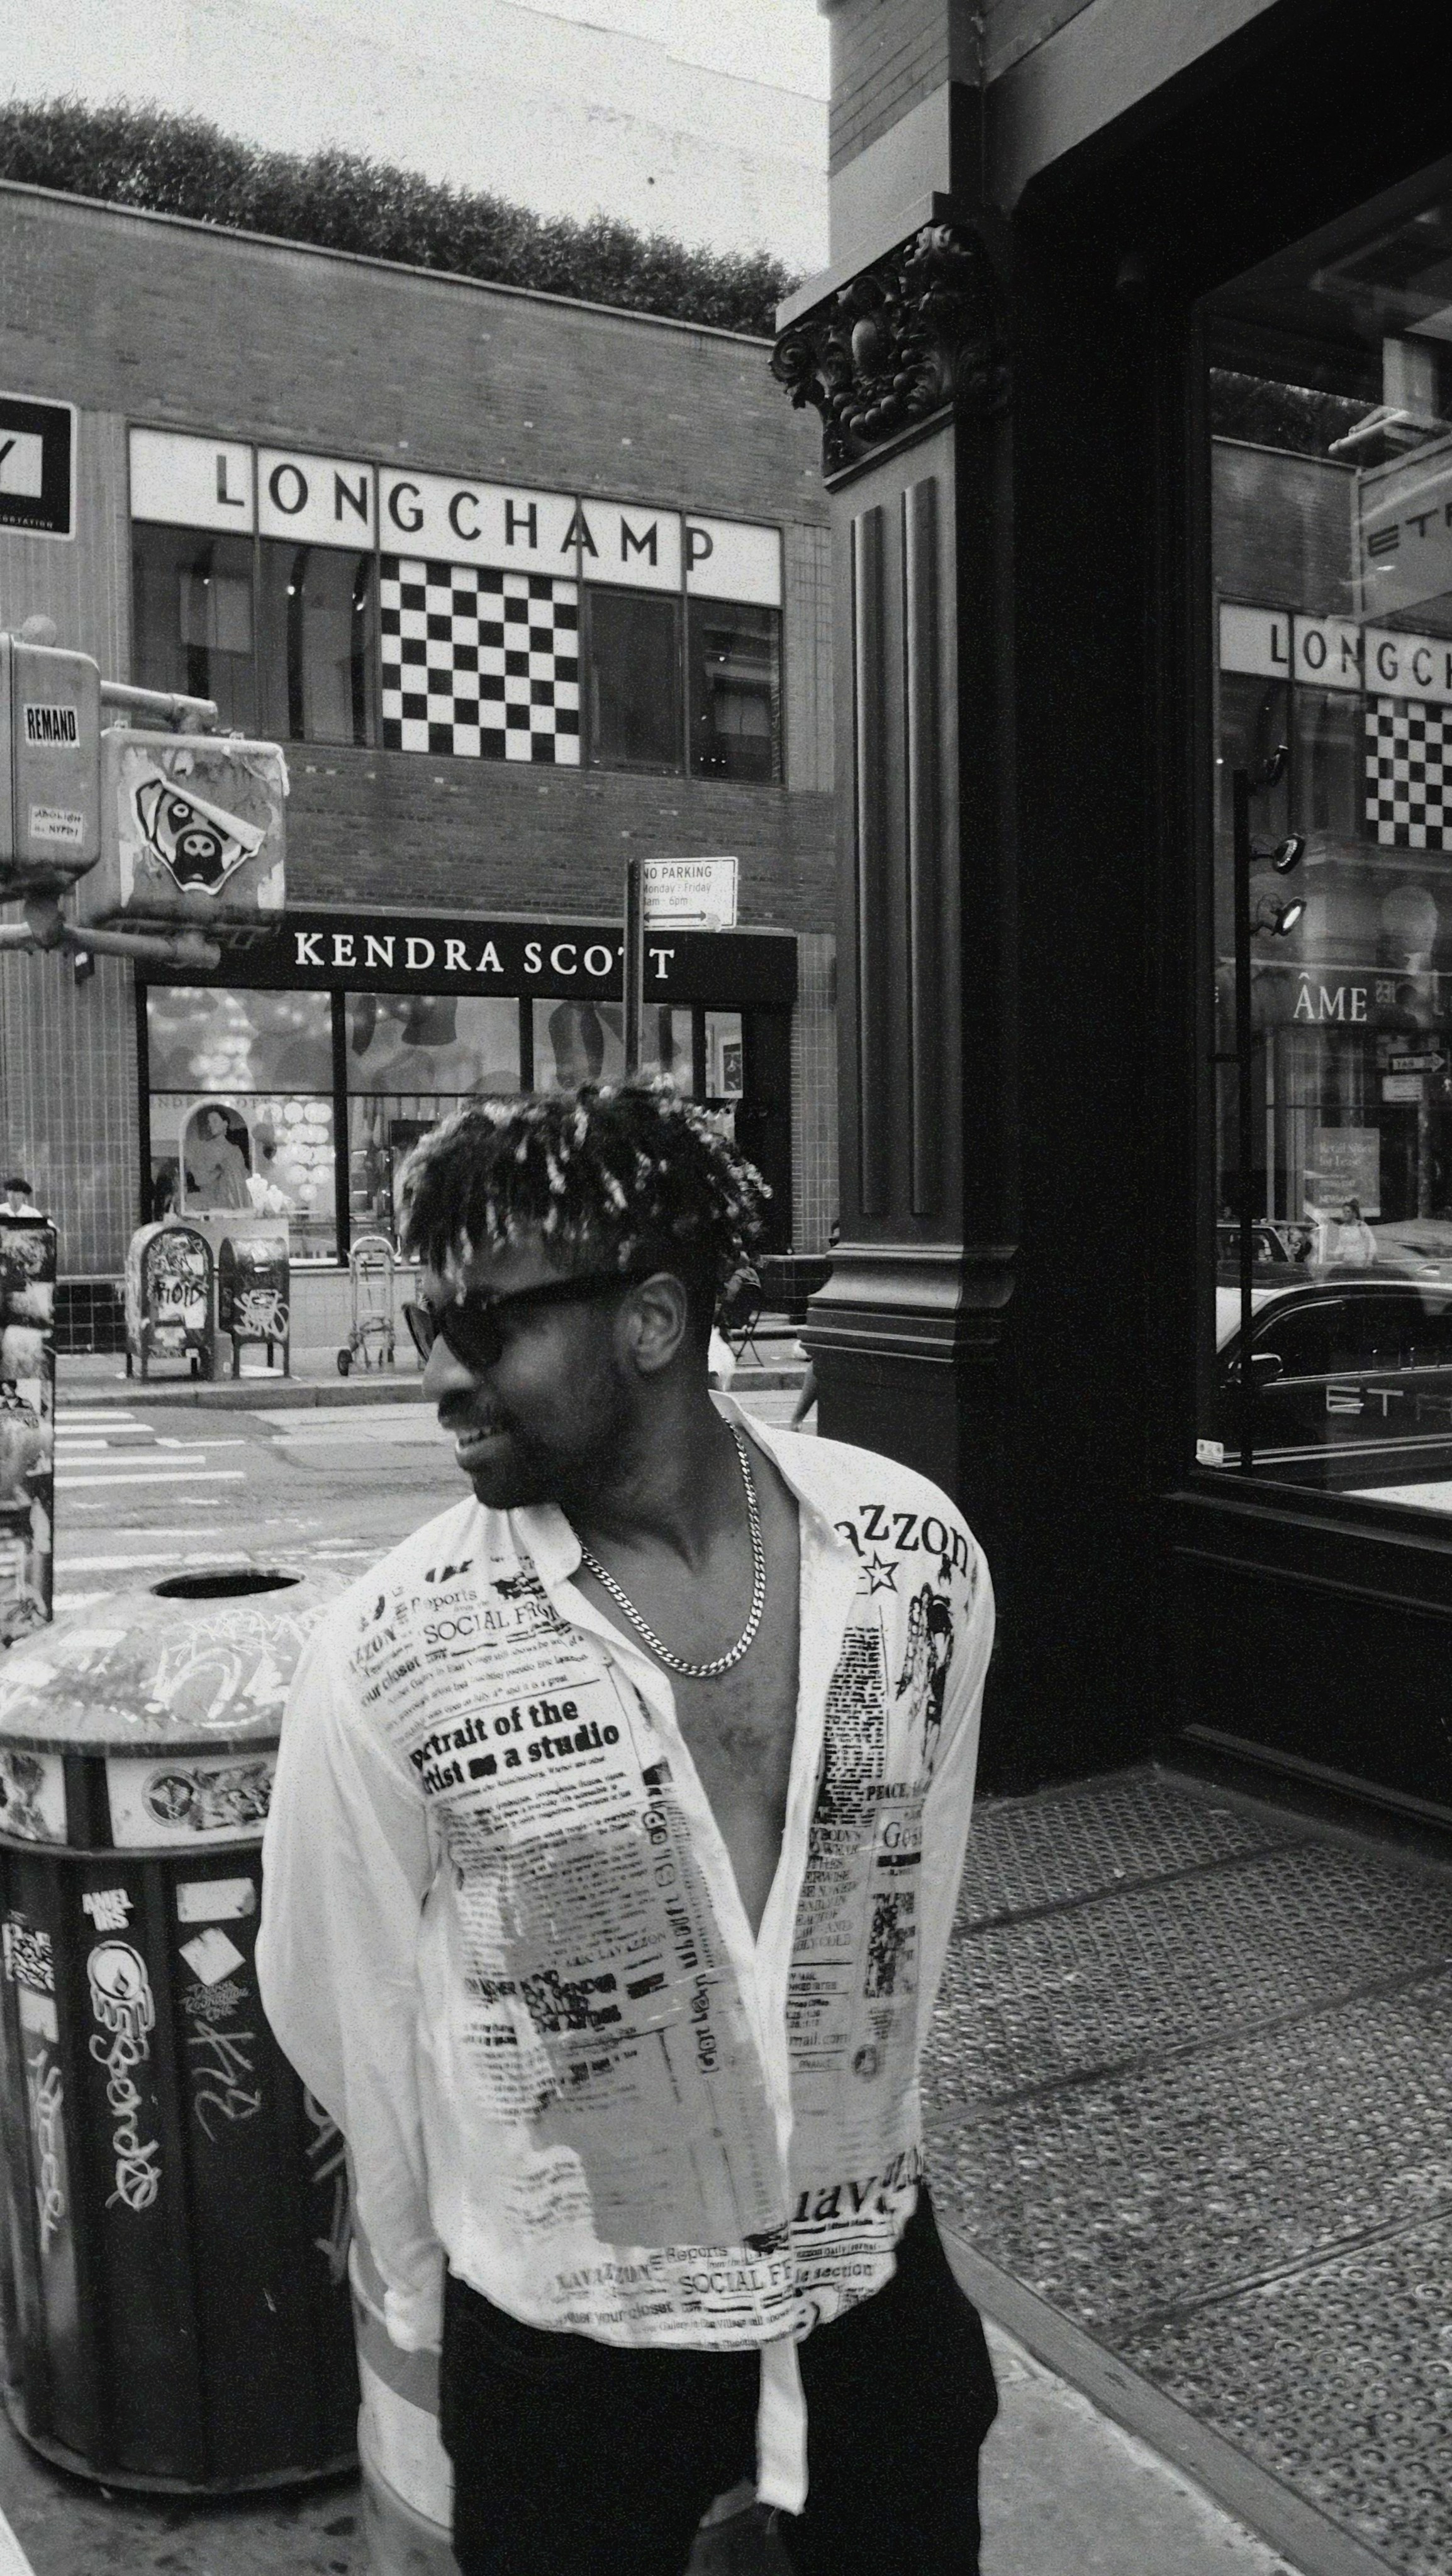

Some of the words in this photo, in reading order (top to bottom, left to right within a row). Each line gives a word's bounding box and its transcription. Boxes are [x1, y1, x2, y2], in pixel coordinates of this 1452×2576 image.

[216, 454, 713, 572] LONGCHAMP
[1367, 501, 1452, 557] ET
[27, 708, 77, 741] REMAND
[643, 867, 657, 879] NO
[662, 865, 712, 879] PARKING
[643, 884, 675, 894] Monday
[684, 883, 712, 893] Friday
[669, 897, 688, 907] 6pm
[294, 932, 504, 973] KENDRA
[523, 942, 675, 979] SCOT
[1293, 972, 1368, 1021] ÂME
[423, 1611, 510, 1644] SOCIAL
[494, 1706, 523, 1736] of
[528, 1700, 579, 1728] the
[504, 1748, 522, 1768] a
[527, 1721, 620, 1763] studio
[679, 2267, 764, 2295] SOCIAL
